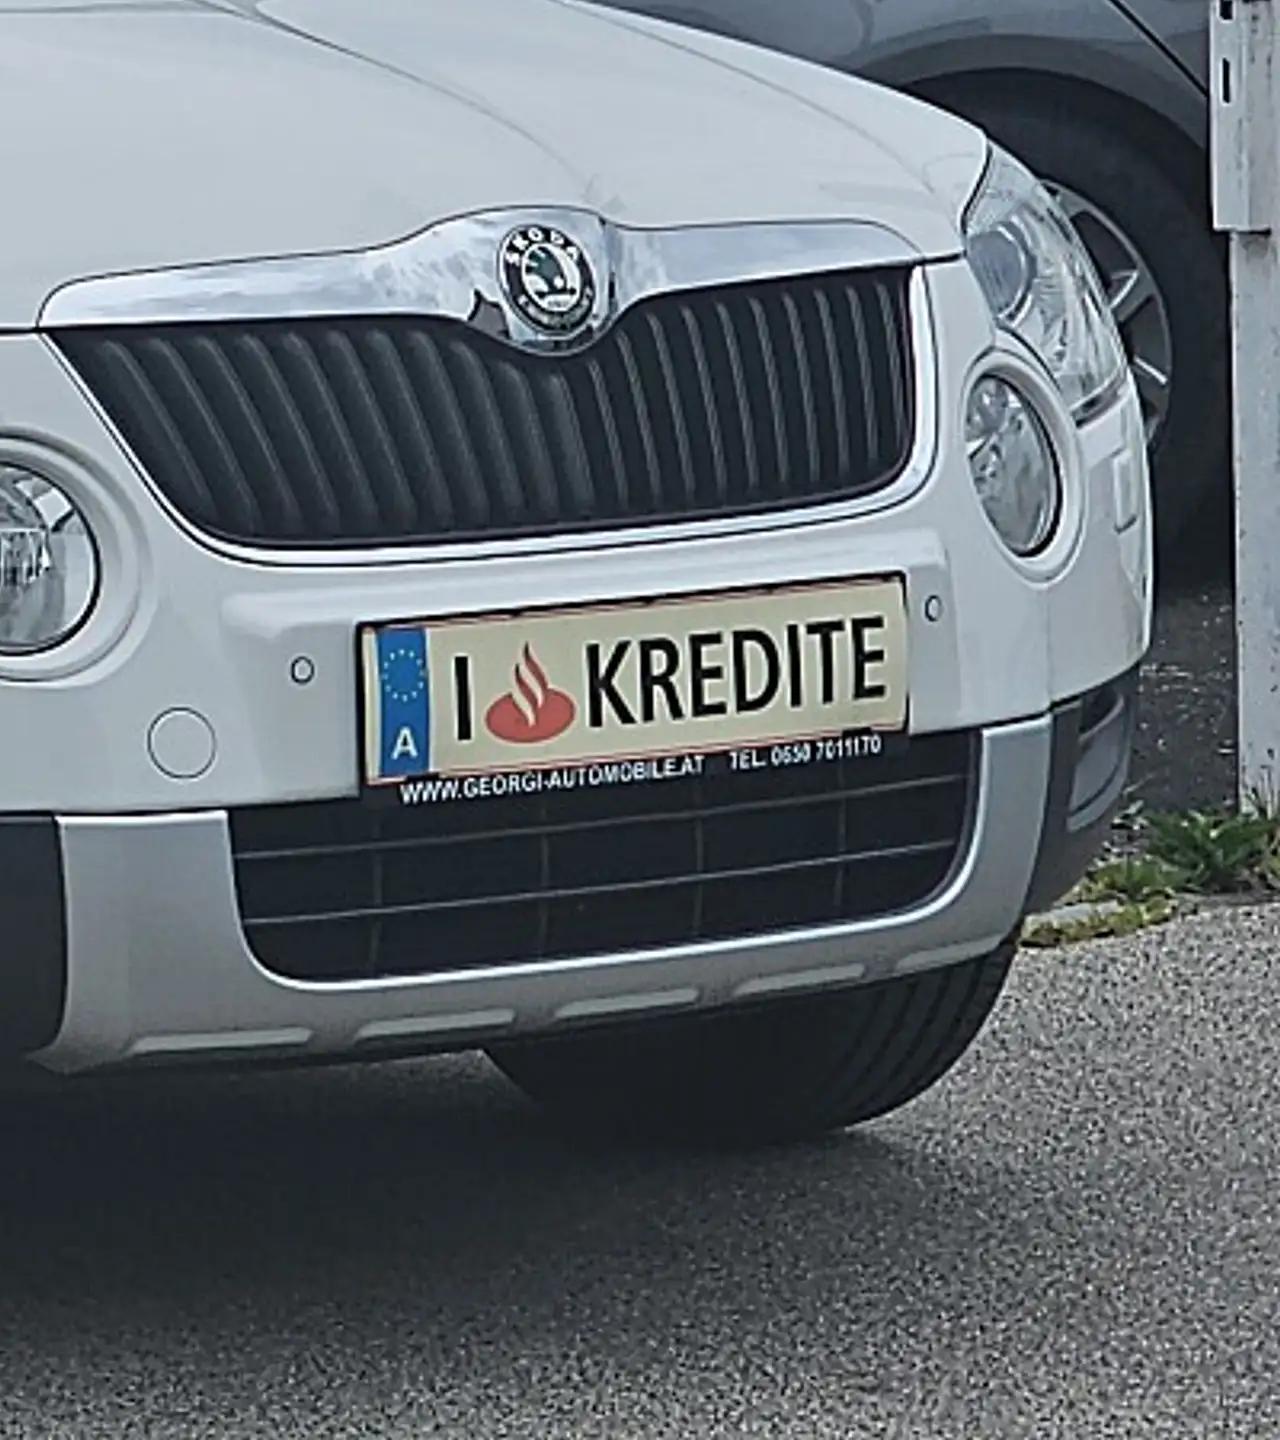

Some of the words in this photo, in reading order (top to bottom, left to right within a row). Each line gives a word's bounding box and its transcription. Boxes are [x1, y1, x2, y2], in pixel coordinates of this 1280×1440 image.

[585, 614, 887, 729] KREDITE
[391, 725, 419, 761] A
[399, 754, 705, 805] WWW.GEORGI-AUTOMOBILE.AT
